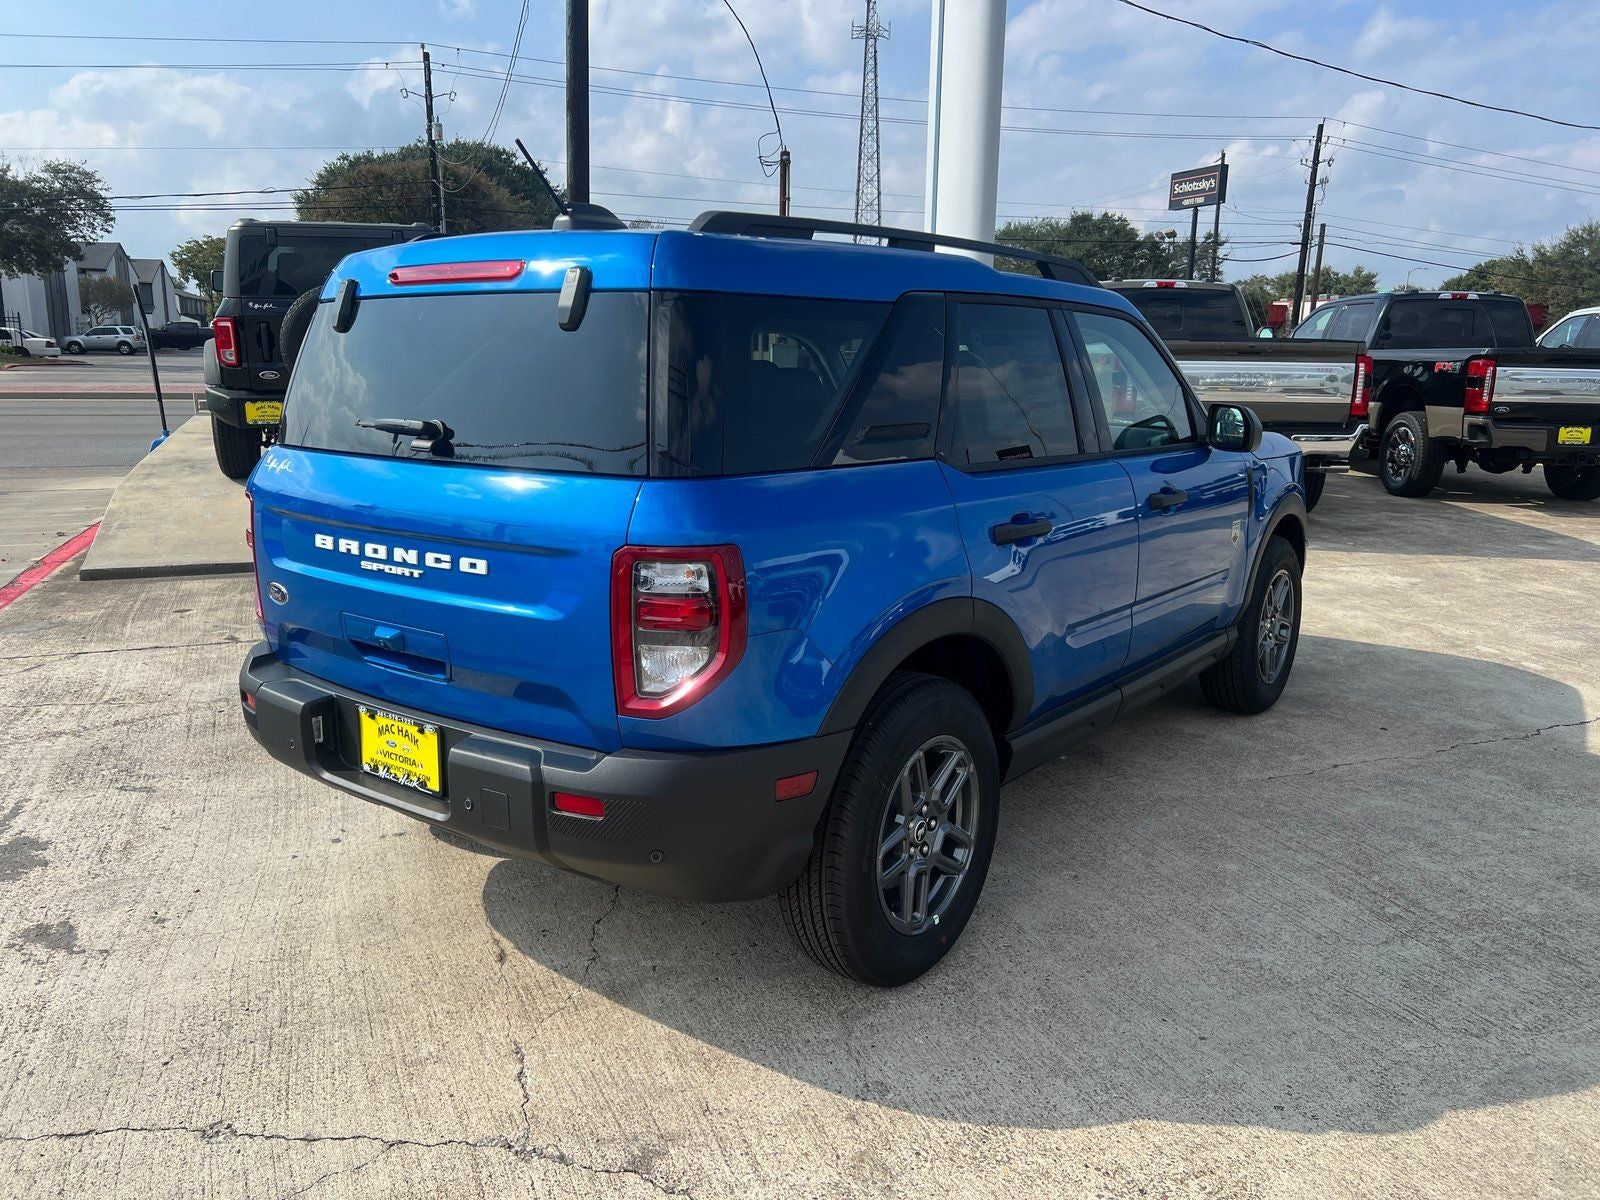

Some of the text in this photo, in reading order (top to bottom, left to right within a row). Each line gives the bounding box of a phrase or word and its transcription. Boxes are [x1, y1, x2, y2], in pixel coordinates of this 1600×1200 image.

[1174, 178, 1215, 193] Schlotzsky's
[1434, 361, 1462, 373] FX4
[314, 533, 488, 575] BRONCO
[360, 560, 424, 578] SPORT
[378, 723, 396, 738] MAC
[397, 725, 420, 749] HAIK
[381, 750, 418, 767] VICTORIA
[377, 766, 398, 782] Mac
